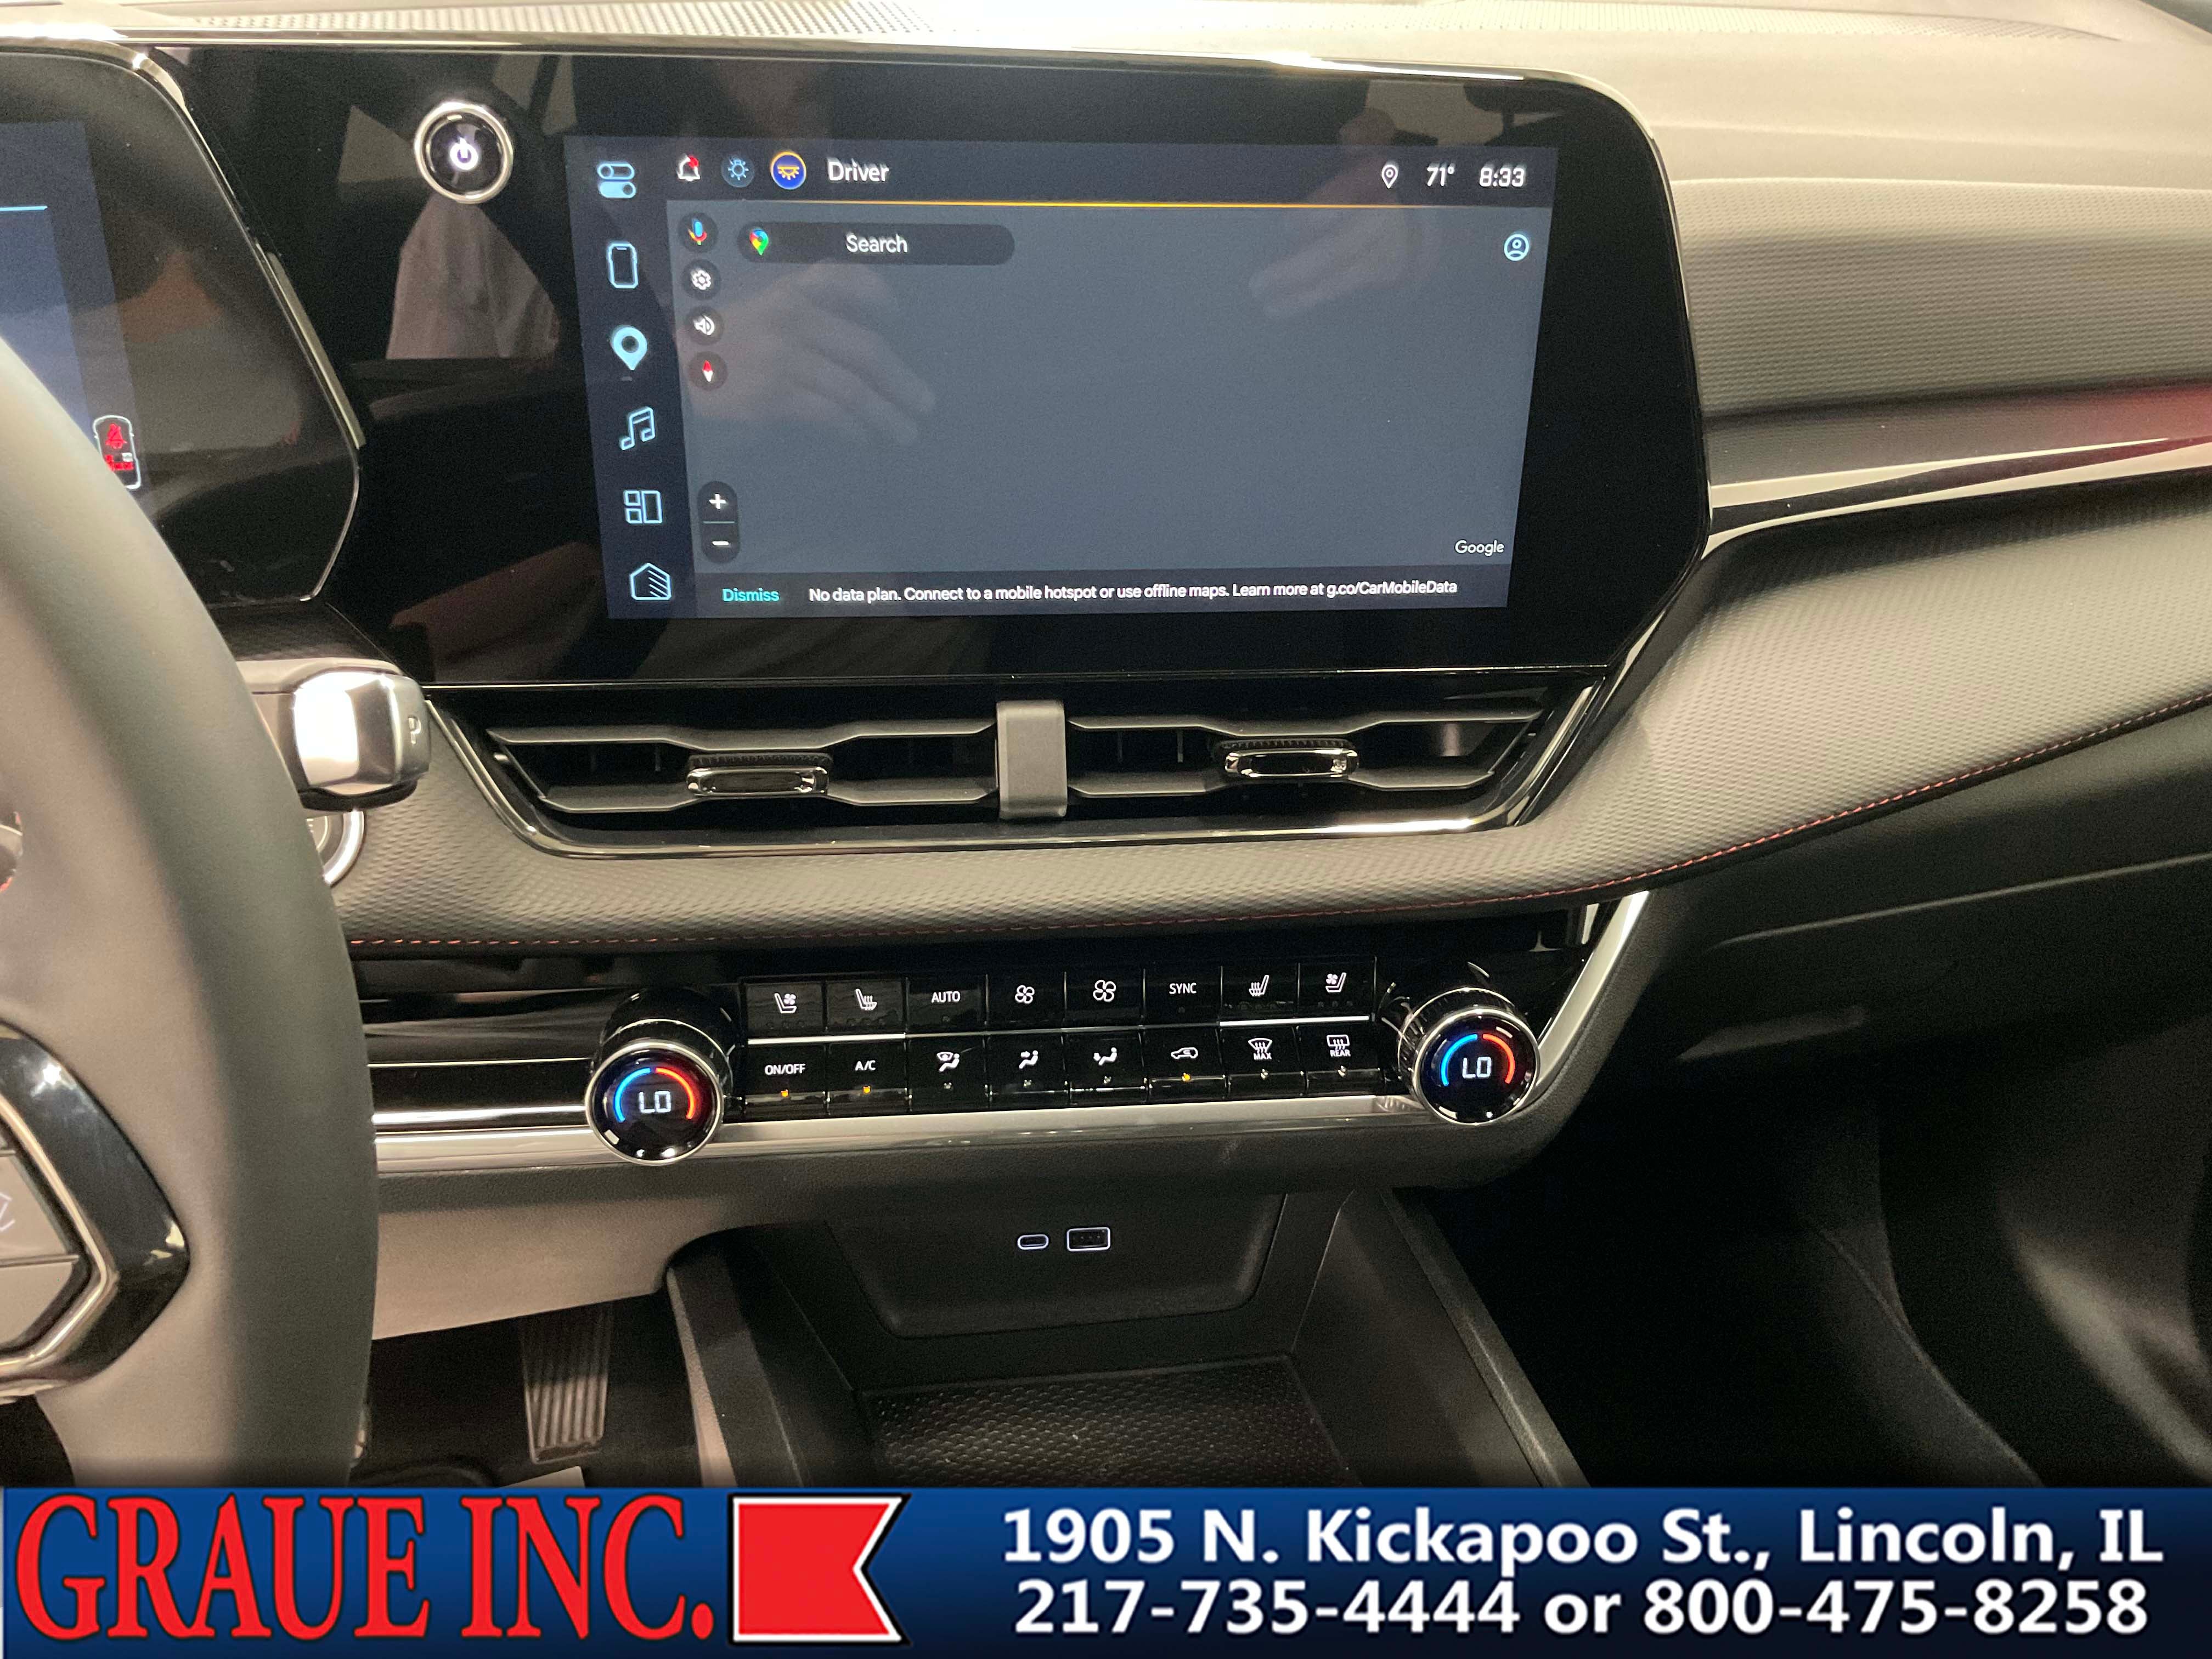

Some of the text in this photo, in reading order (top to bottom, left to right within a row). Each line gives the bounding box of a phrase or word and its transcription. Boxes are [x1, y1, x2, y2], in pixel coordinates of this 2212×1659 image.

[827, 158, 889, 183] Driver
[1480, 167, 1525, 188] 8:33
[846, 233, 909, 256] Search
[1455, 539, 1504, 557] Google
[723, 588, 780, 602] Dismiss
[809, 580, 1458, 604] No data plan. Connect to a mobile hotspot or use offline maps. Learn more at g.co/CarMobileData
[932, 991, 961, 1003] AUTO
[1169, 983, 1197, 995] SYNC
[1330, 1049, 1351, 1057] REAR
[765, 1063, 805, 1075] ON/OFF
[855, 1060, 876, 1071] A/C
[1462, 1057, 1492, 1079] LO
[639, 1090, 671, 1113] LO
